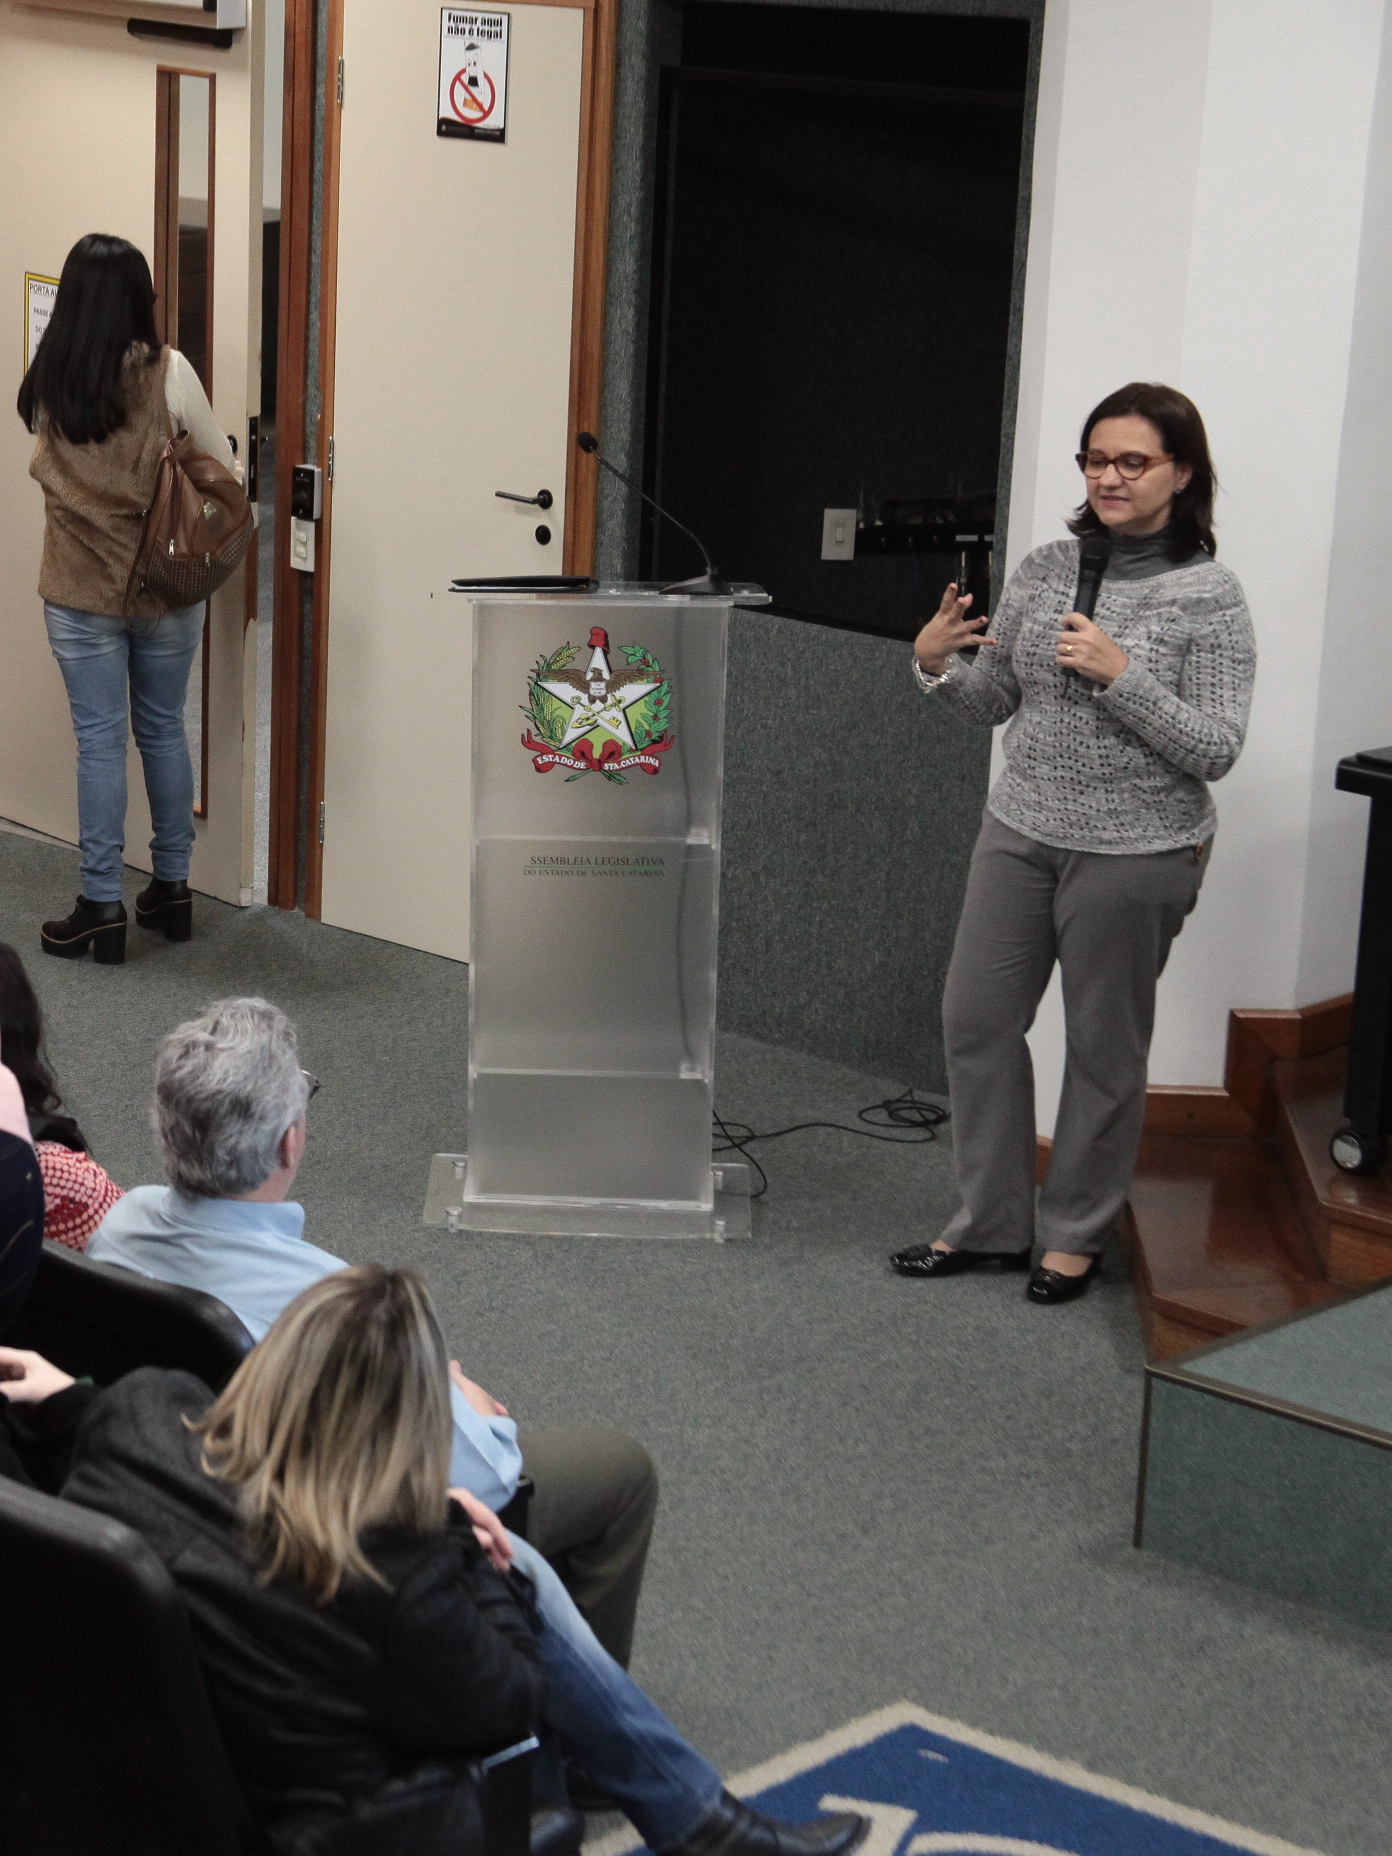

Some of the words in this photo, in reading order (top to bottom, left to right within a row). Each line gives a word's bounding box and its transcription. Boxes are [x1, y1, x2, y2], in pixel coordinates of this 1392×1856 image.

[448, 12, 478, 25] Fumar
[481, 16, 503, 28] aqui
[448, 23, 466, 36] não
[477, 27, 503, 40] legal
[30, 283, 49, 296] PORTA
[537, 754, 573, 766] ESTADO
[573, 760, 587, 770] DE
[594, 856, 665, 867] LEGISLATIVA
[538, 869, 574, 877] ESTADO
[576, 869, 588, 877] DE
[621, 869, 665, 878] CATARINA
